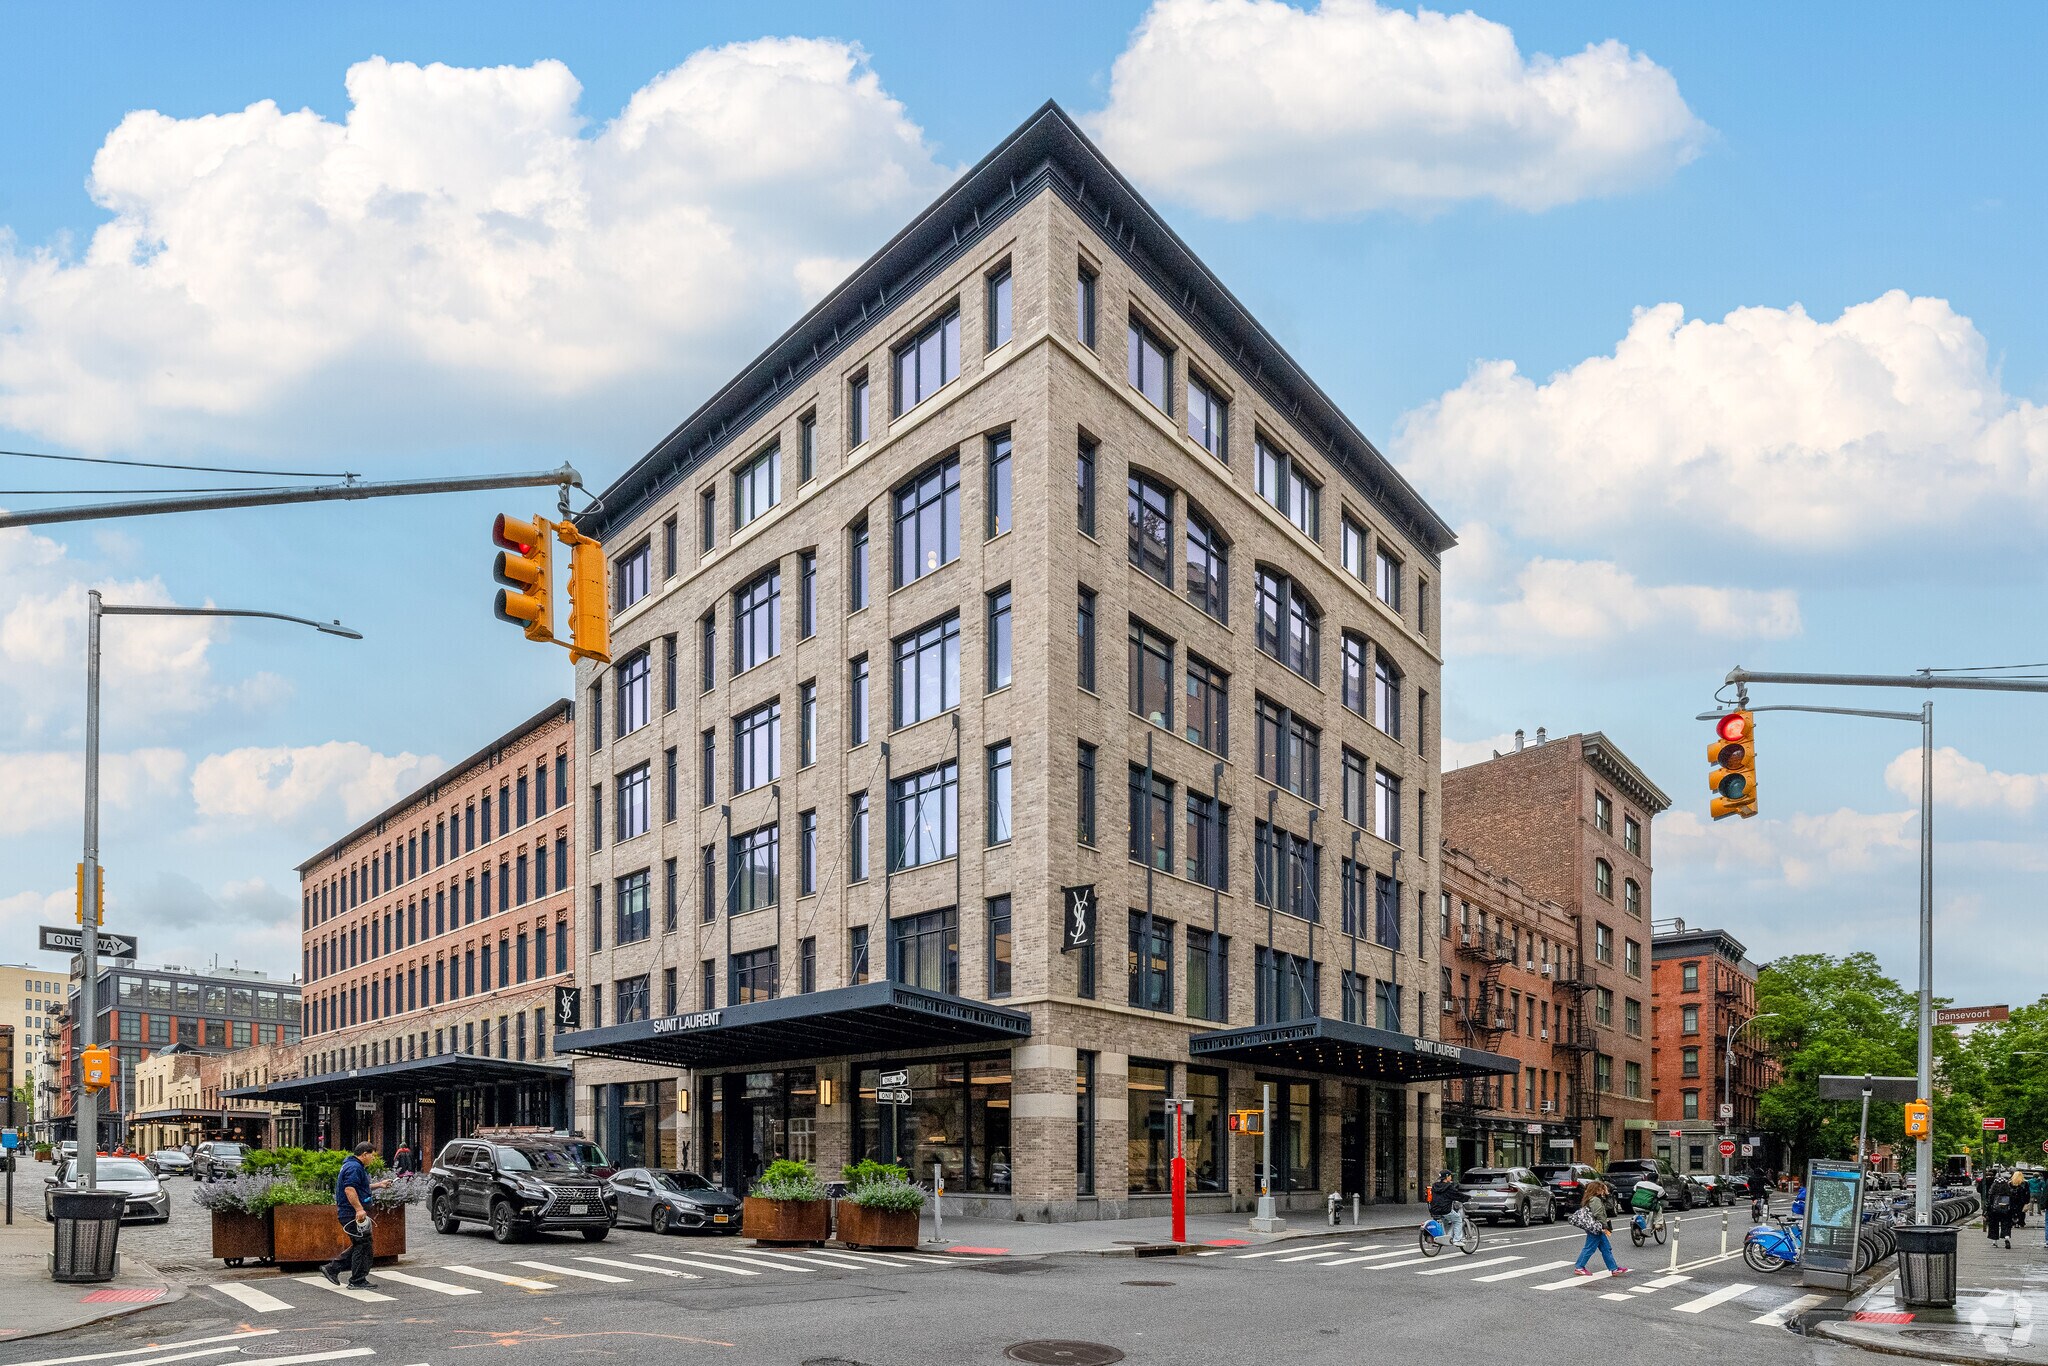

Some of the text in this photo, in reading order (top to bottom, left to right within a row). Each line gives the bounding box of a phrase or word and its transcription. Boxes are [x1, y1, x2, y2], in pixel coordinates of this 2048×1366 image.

[54, 935, 122, 950] ONE WAY
[654, 1012, 720, 1033] SAINT LAURENT
[1938, 1010, 1990, 1020] Gansevoort
[1414, 1038, 1461, 1058] SAINT LAURENT
